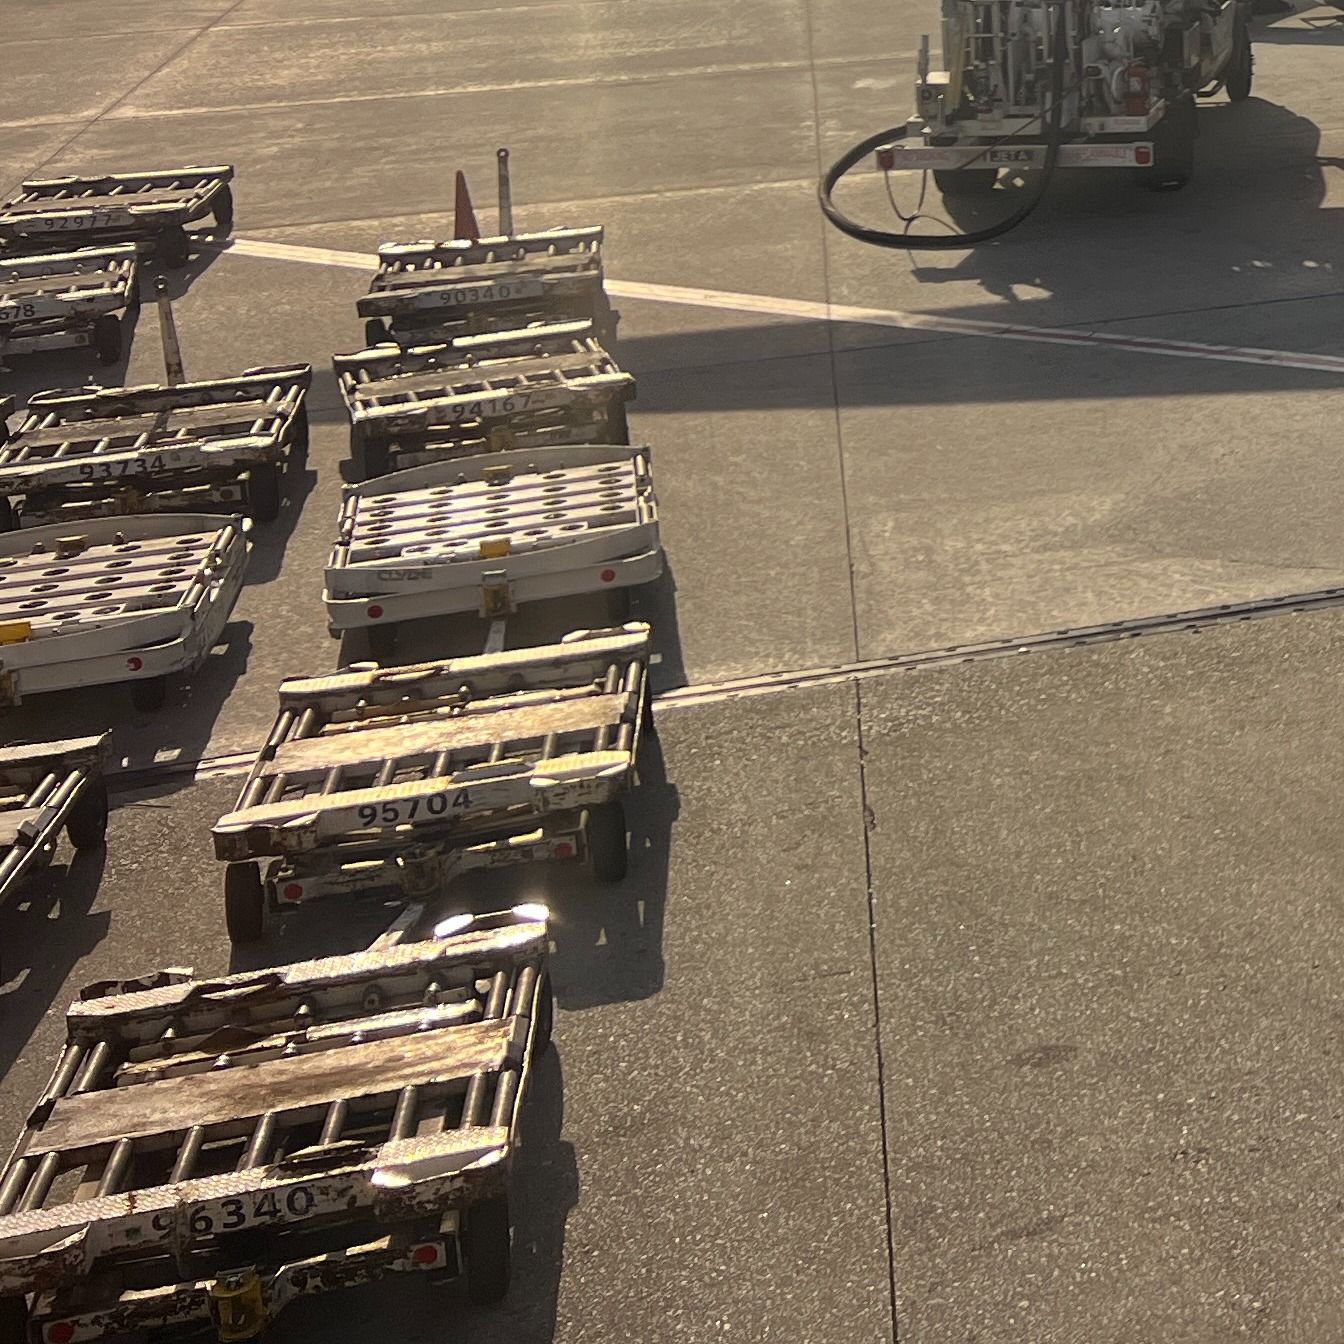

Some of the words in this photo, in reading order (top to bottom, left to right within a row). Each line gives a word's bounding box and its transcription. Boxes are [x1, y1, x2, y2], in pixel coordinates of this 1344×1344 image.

[44, 213, 113, 231] 92977
[440, 286, 511, 305] 90340
[452, 394, 532, 420] 94167
[79, 456, 166, 481] 93734
[357, 787, 474, 827] 95704
[151, 1185, 316, 1241] 96340
